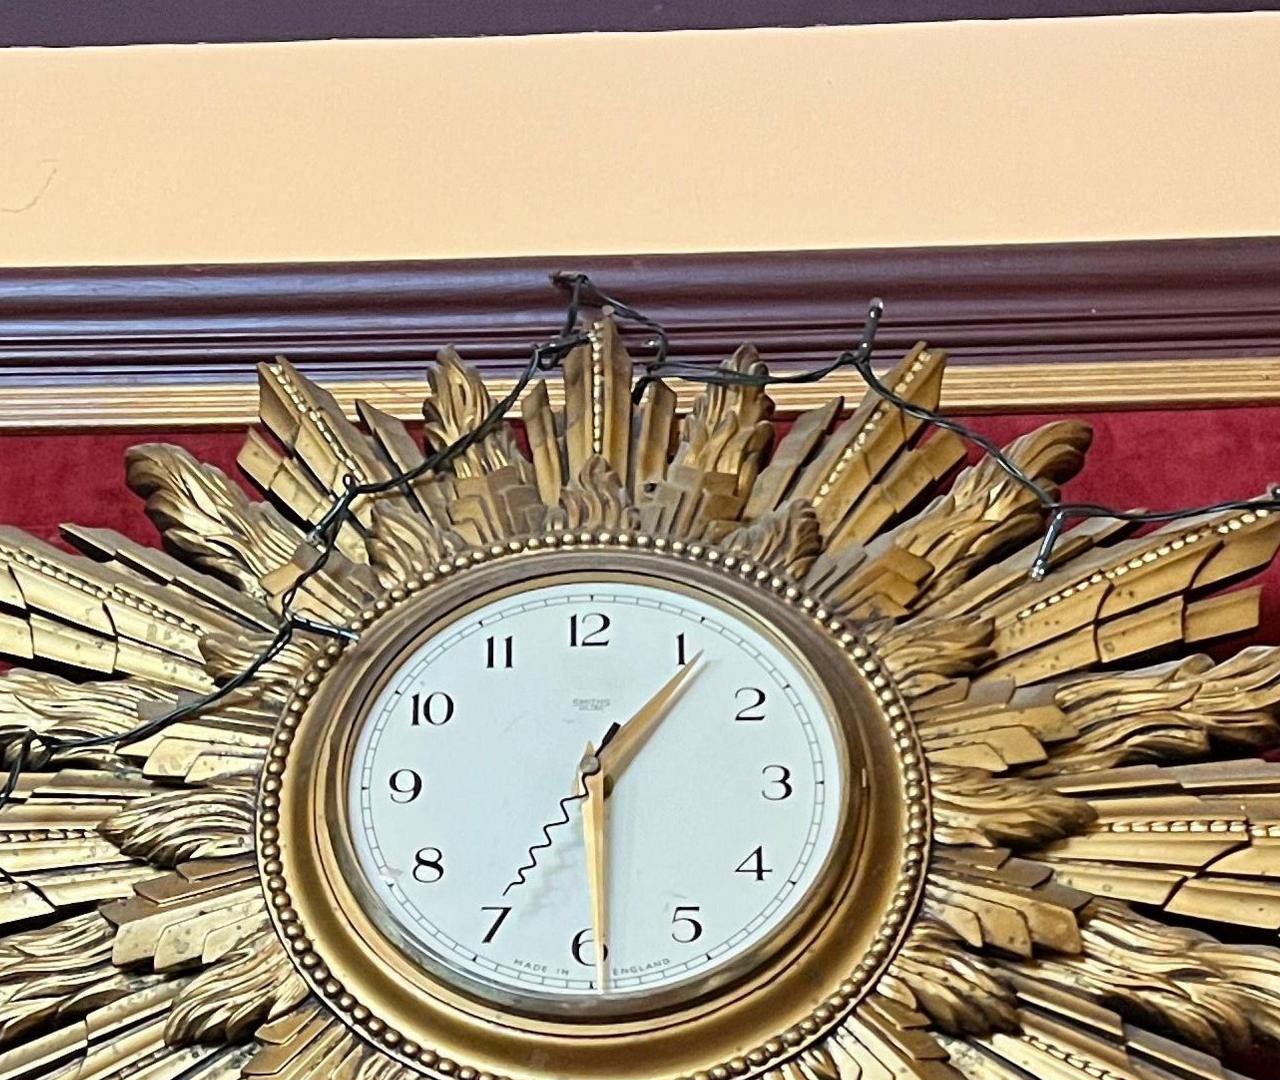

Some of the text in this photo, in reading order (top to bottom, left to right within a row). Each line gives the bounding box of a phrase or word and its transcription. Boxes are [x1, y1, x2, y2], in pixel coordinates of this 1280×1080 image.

[570, 613, 610, 647] 12
[486, 635, 513, 669] 11
[677, 633, 686, 666] 1
[411, 692, 454, 726] 10
[734, 687, 766, 721] 2
[389, 769, 422, 803] 9
[761, 765, 793, 801] 3
[412, 847, 444, 883] 8
[734, 845, 773, 881] 4
[481, 906, 512, 943] 7
[671, 906, 703, 943] 5
[571, 928, 609, 967] 6
[513, 958, 671, 976] MADE IN ENGLAND
